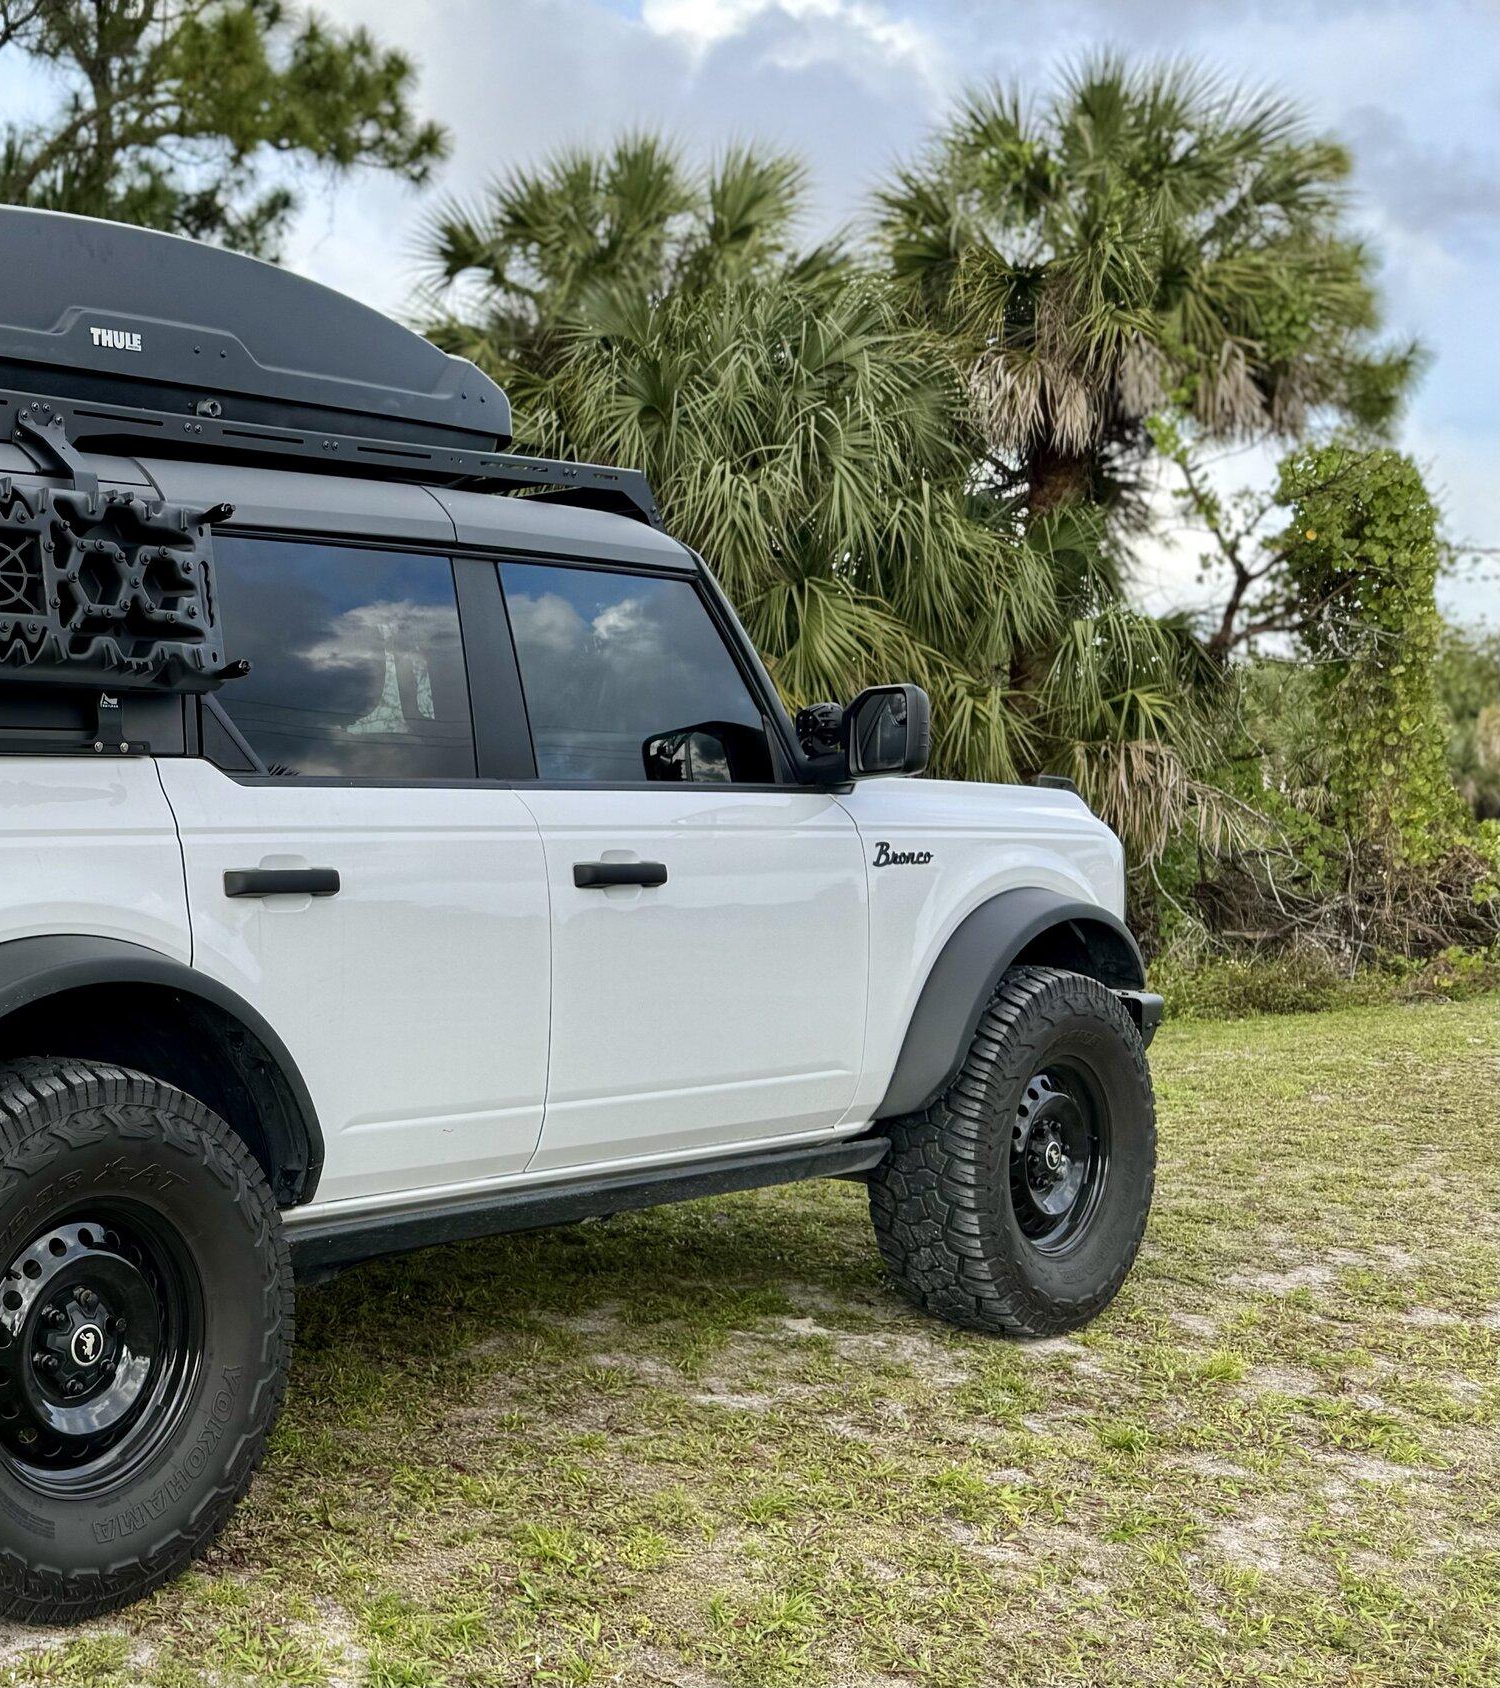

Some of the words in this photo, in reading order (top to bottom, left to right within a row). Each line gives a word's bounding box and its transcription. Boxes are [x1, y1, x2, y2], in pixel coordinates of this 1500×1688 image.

[90, 326, 142, 352] THULE
[872, 841, 934, 868] Bronco
[93, 1364, 243, 1545] YOKOHAMA
